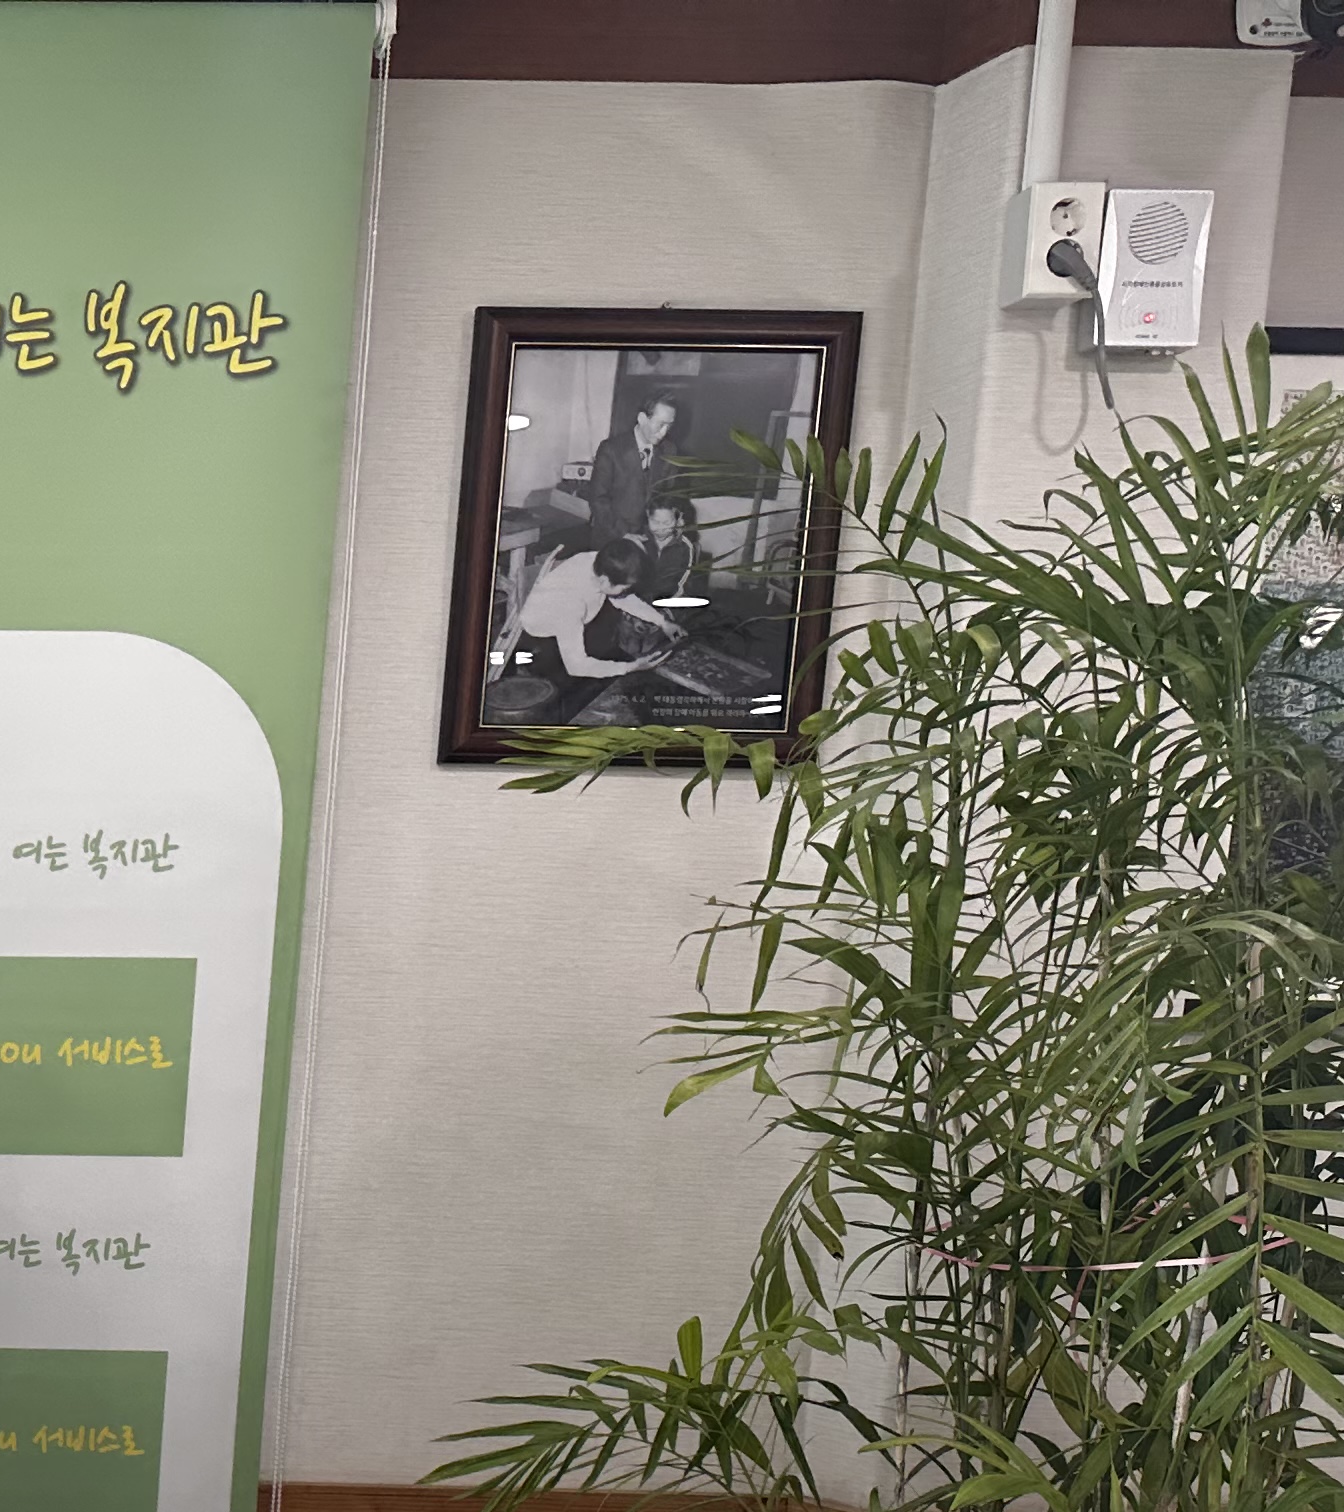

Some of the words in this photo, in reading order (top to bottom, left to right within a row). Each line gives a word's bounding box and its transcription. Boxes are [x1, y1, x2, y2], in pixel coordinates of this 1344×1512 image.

[88, 286, 281, 386] 복지관
[13, 836, 68, 872] 여는
[83, 829, 179, 880] 복지관
[58, 1036, 171, 1069] 서비스로
[56, 1229, 150, 1276] 복지관
[34, 1425, 144, 1455] 서비스로
